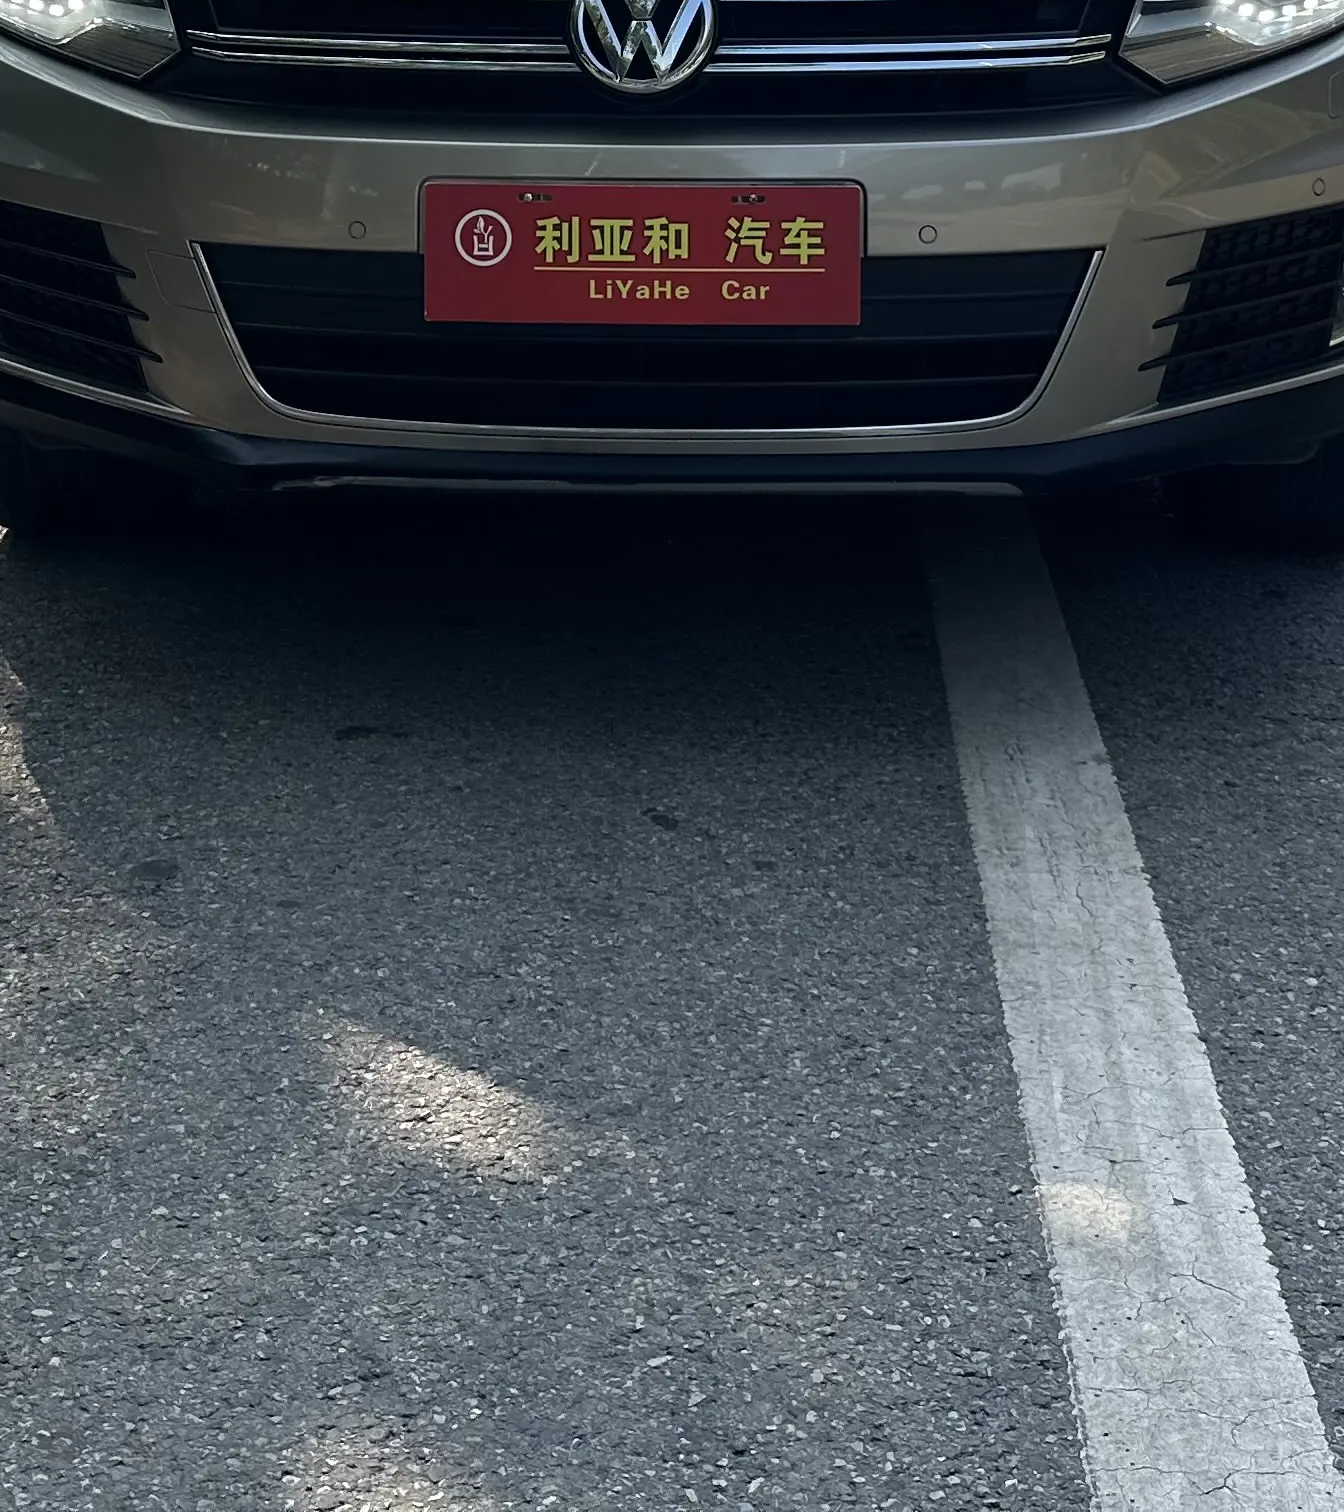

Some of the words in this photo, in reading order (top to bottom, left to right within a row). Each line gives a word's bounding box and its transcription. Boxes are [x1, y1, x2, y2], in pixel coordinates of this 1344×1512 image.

[534, 215, 690, 265] 利亚和
[723, 216, 826, 265] 汽车
[589, 279, 690, 300] LiYaHe
[721, 280, 770, 300] Car
